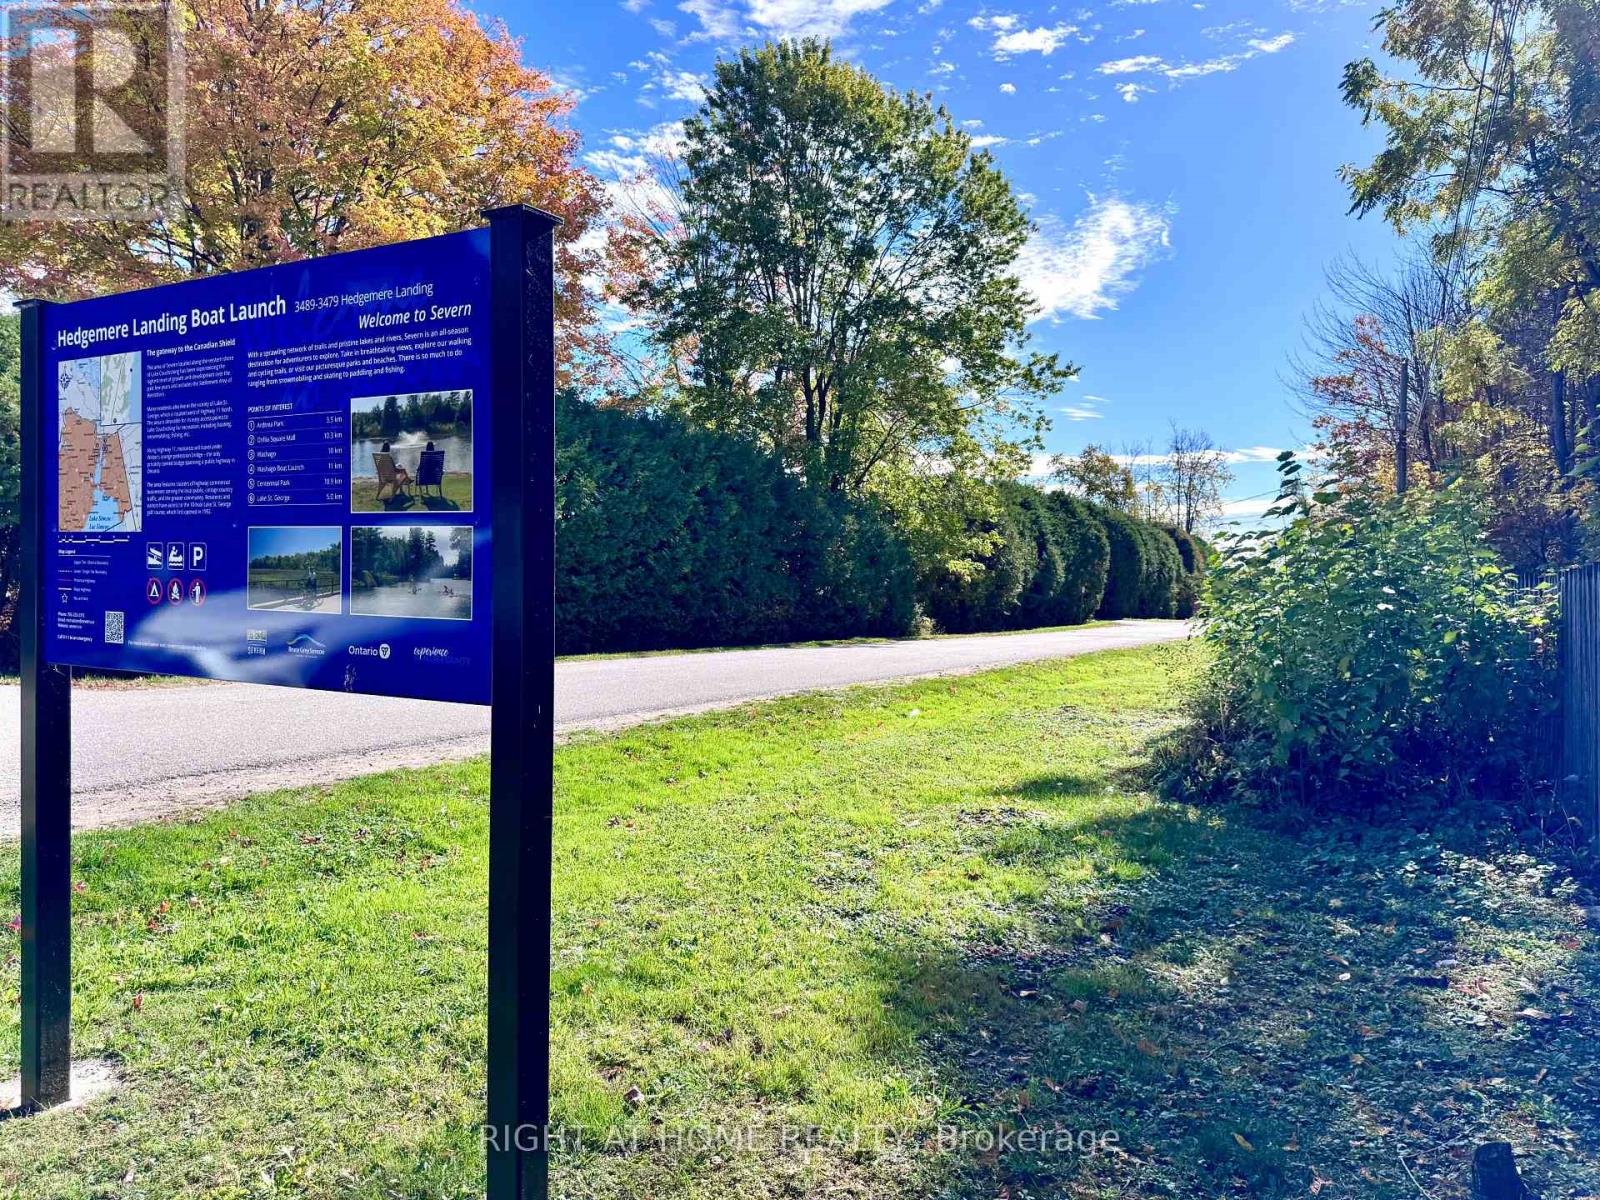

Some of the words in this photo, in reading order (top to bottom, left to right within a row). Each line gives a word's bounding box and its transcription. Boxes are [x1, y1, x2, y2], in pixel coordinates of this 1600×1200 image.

[294, 296, 338, 312] 3489-3479
[341, 289, 392, 306] Hedgemere
[396, 282, 434, 298] Landing
[57, 324, 128, 348] Hedgemere
[132, 313, 186, 334] Landing
[191, 306, 225, 328] Boat
[230, 294, 286, 322] Launch
[359, 310, 410, 328] Welcome
[414, 308, 426, 322] to
[430, 304, 472, 320] Severn
[147, 348, 157, 356] The
[157, 346, 178, 356] gateway
[186, 343, 194, 351] the
[195, 340, 219, 350] Canadian
[220, 338, 236, 347] Shield
[287, 345, 307, 353] network
[360, 337, 373, 345] lakes
[404, 332, 423, 340] Severn
[440, 326, 469, 336] all-season
[248, 359, 274, 368] destination
[282, 355, 312, 364] adventurers
[361, 345, 395, 357] breathtaking
[414, 341, 435, 351] explore
[449, 337, 471, 347] walking
[258, 368, 273, 377] cycling
[316, 361, 345, 372] picturesque
[346, 359, 361, 369] parks
[374, 356, 397, 364] beaches.
[398, 354, 414, 362] There
[430, 351, 445, 359] much
[248, 378, 265, 387] ranging
[279, 374, 312, 384] snowmobiling
[324, 372, 342, 381] skating
[350, 369, 373, 378] paddling
[272, 402, 293, 411] INTEREST
[349, 645, 378, 656] Ontario
[414, 646, 449, 660] experience
